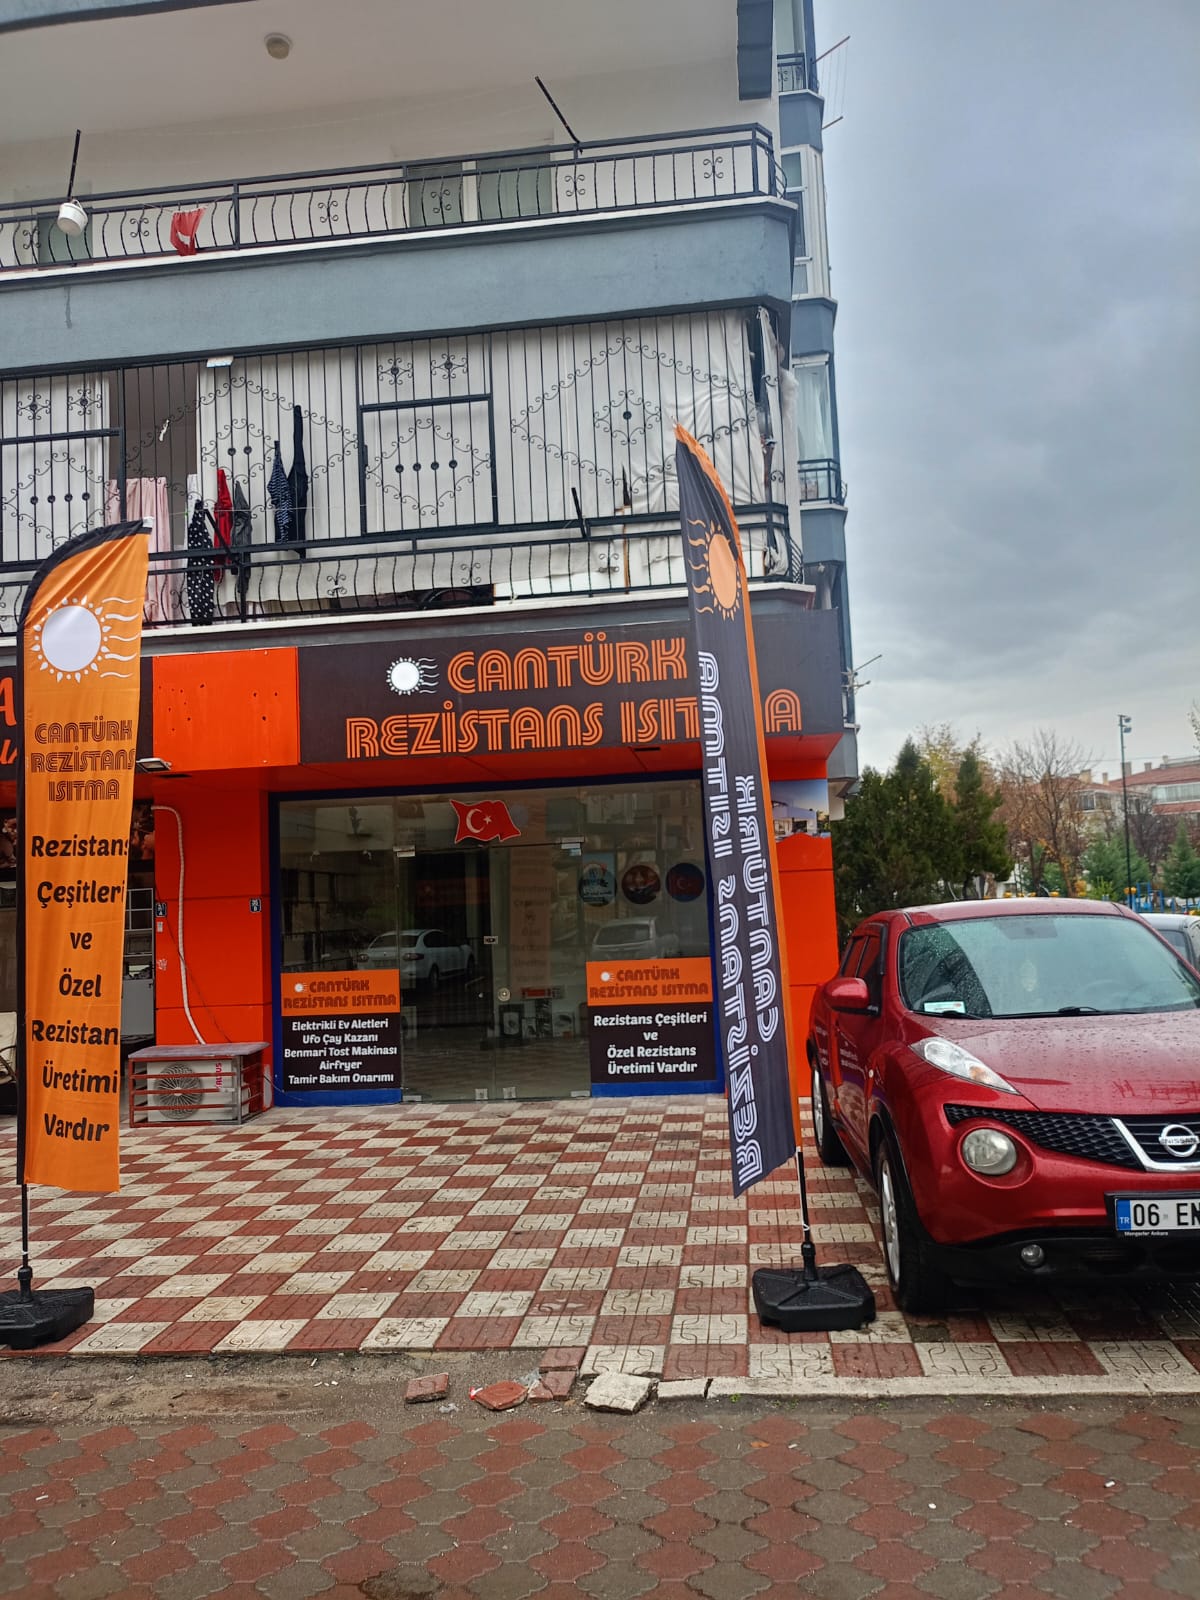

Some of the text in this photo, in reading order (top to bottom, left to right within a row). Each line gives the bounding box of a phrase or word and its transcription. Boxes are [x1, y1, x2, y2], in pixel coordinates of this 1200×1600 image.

[447, 632, 688, 694] CANTÜRK
[35, 716, 133, 744] CANTÜRK
[346, 689, 802, 759] REZİSTANS ISITA
[49, 779, 120, 802] ISITMA
[70, 932, 93, 950] ve
[616, 966, 680, 982] CANTÜRK
[59, 968, 102, 997] Özel
[309, 977, 370, 993] CANTÜRK
[589, 982, 709, 998] REZİSTANS ISITMA
[283, 994, 397, 1009] REZİSTANS ISITMA
[291, 1018, 389, 1031] Elektrikli Ev Aletleri
[593, 1011, 708, 1027] Rezistans Çeşitleri
[32, 1019, 119, 1045] Rezistan
[302, 1033, 378, 1045] Ufo Çay Kazanı
[643, 1031, 658, 1041] ve
[284, 1046, 398, 1058] Benmari Tost Makinası
[607, 1044, 697, 1058] Özel Rezistans
[319, 1060, 362, 1071] Airfryer
[607, 1060, 698, 1075] Üretimi Vardır
[43, 1060, 118, 1093] Üretimi
[215, 1062, 223, 1087] ALUS
[288, 1073, 395, 1085] Tamir Bakım Onarımı
[44, 1113, 110, 1141] Vardır
[1119, 1216, 1130, 1225] TR
[1133, 1203, 1160, 1227] 06
